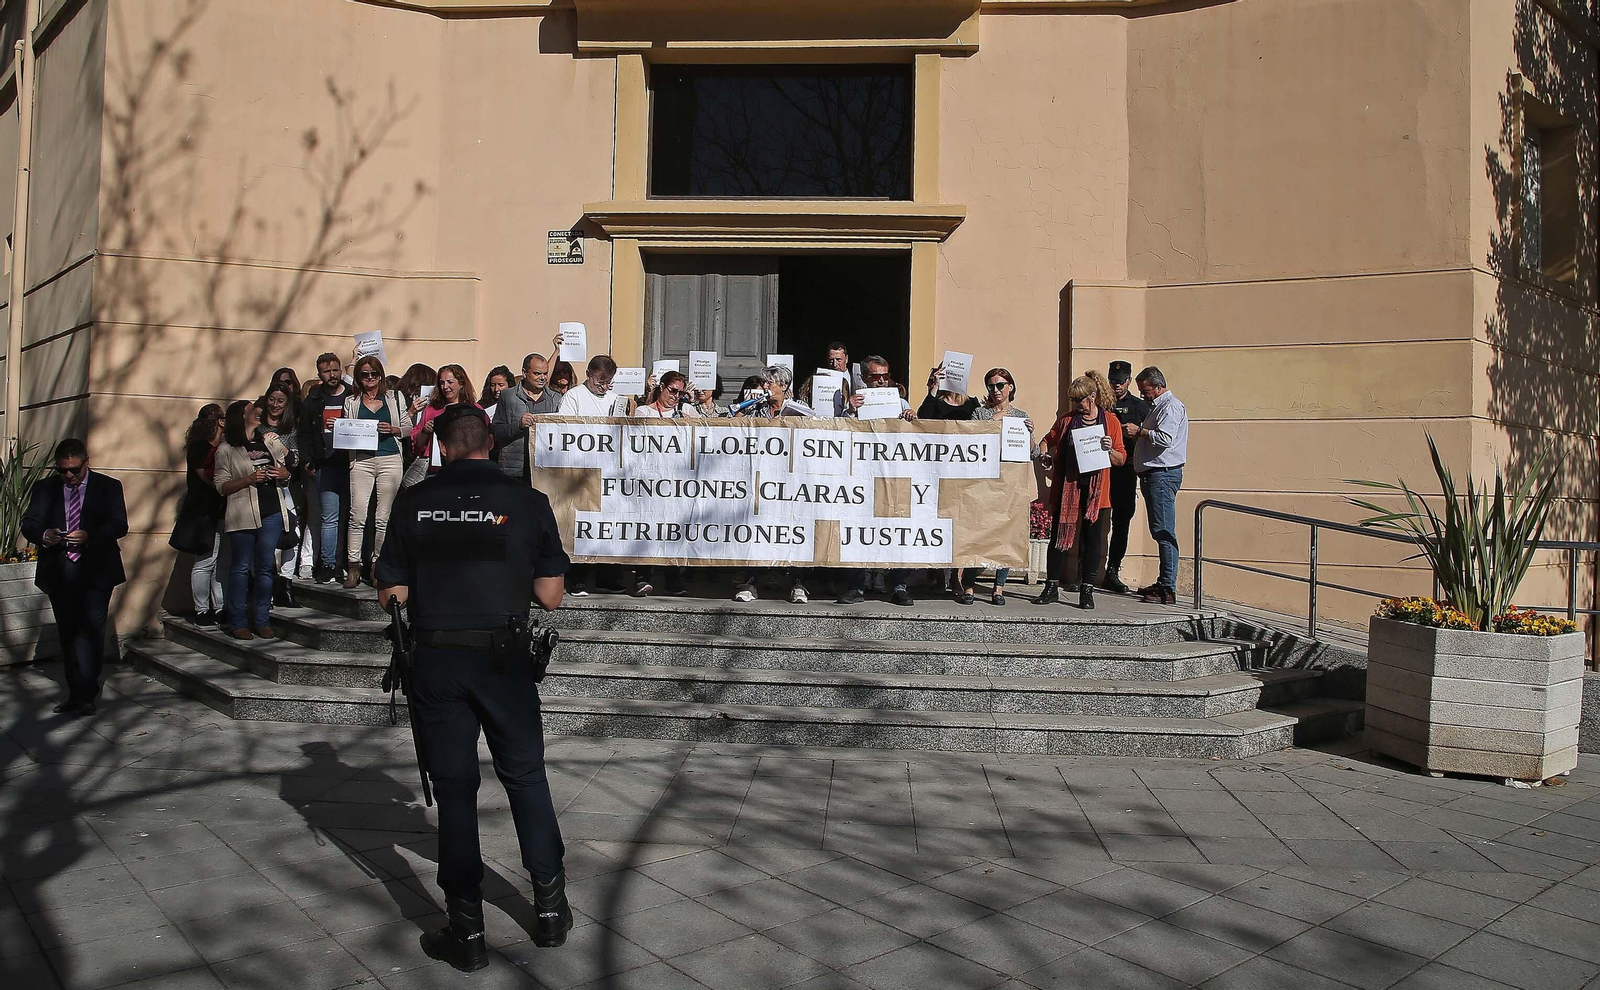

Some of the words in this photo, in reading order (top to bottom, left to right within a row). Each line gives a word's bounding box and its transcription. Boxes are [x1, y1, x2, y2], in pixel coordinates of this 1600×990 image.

[561, 433, 615, 453] POR
[630, 435, 683, 454] UNA
[699, 436, 789, 457] L.O.E.O.
[802, 438, 845, 459] SIN
[853, 441, 988, 463] TRAMPAS!
[602, 477, 748, 500] FUNCIONES
[759, 480, 865, 505] CLARAS
[912, 484, 931, 505] Y
[417, 510, 497, 522] POLICIA
[575, 520, 806, 546] RETRIBUCIONES
[841, 526, 944, 548] JUSTAS
